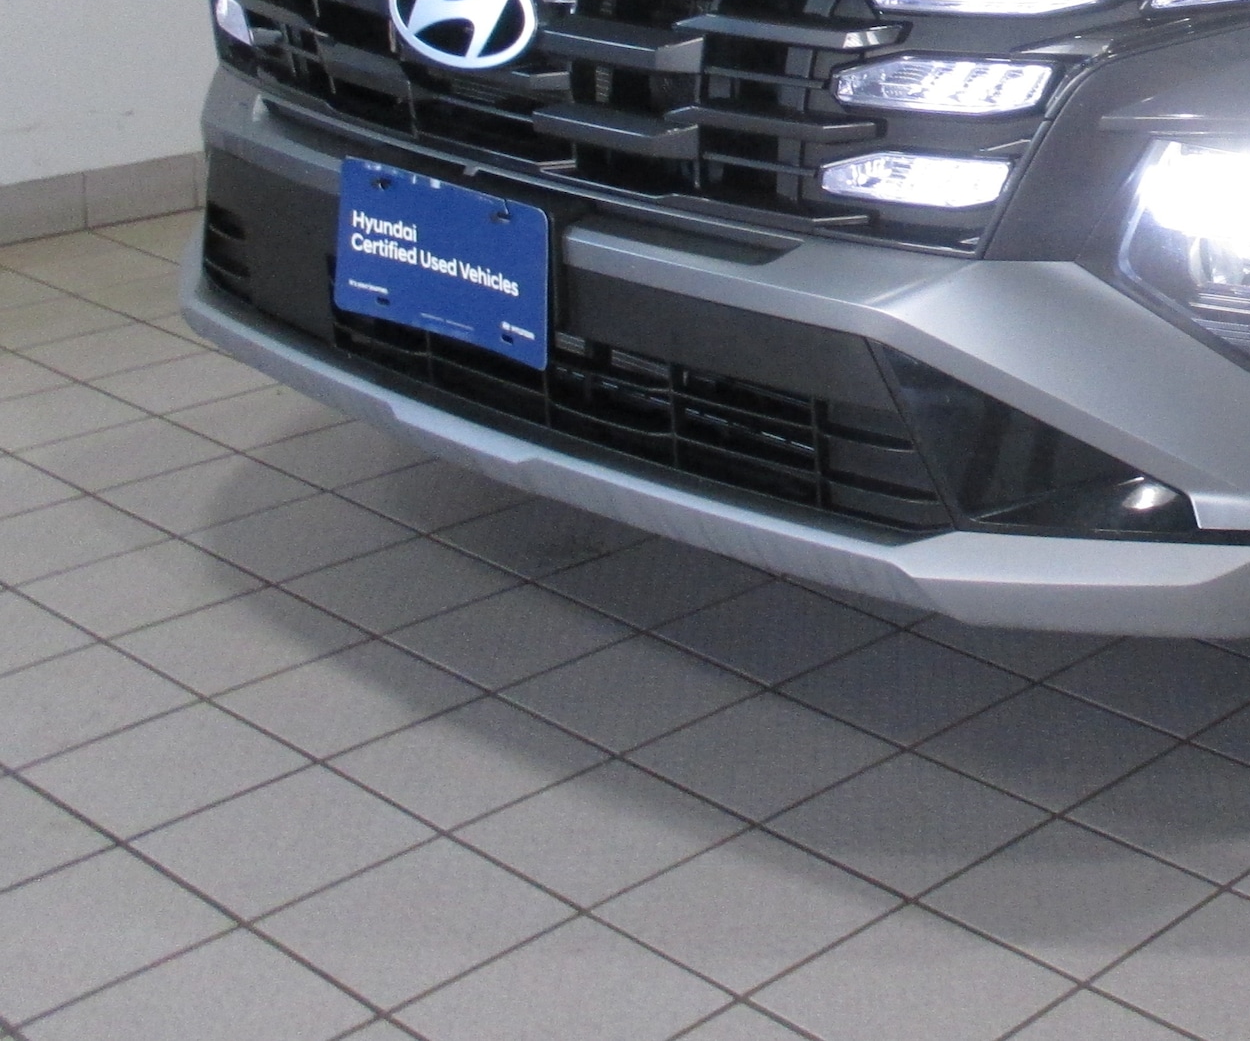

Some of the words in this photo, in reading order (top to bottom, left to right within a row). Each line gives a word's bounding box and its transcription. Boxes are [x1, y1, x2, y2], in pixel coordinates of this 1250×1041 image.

[352, 210, 418, 243] Hyundai
[351, 233, 417, 266] Certified
[420, 249, 457, 277] Used
[459, 260, 519, 297] Vehicles
